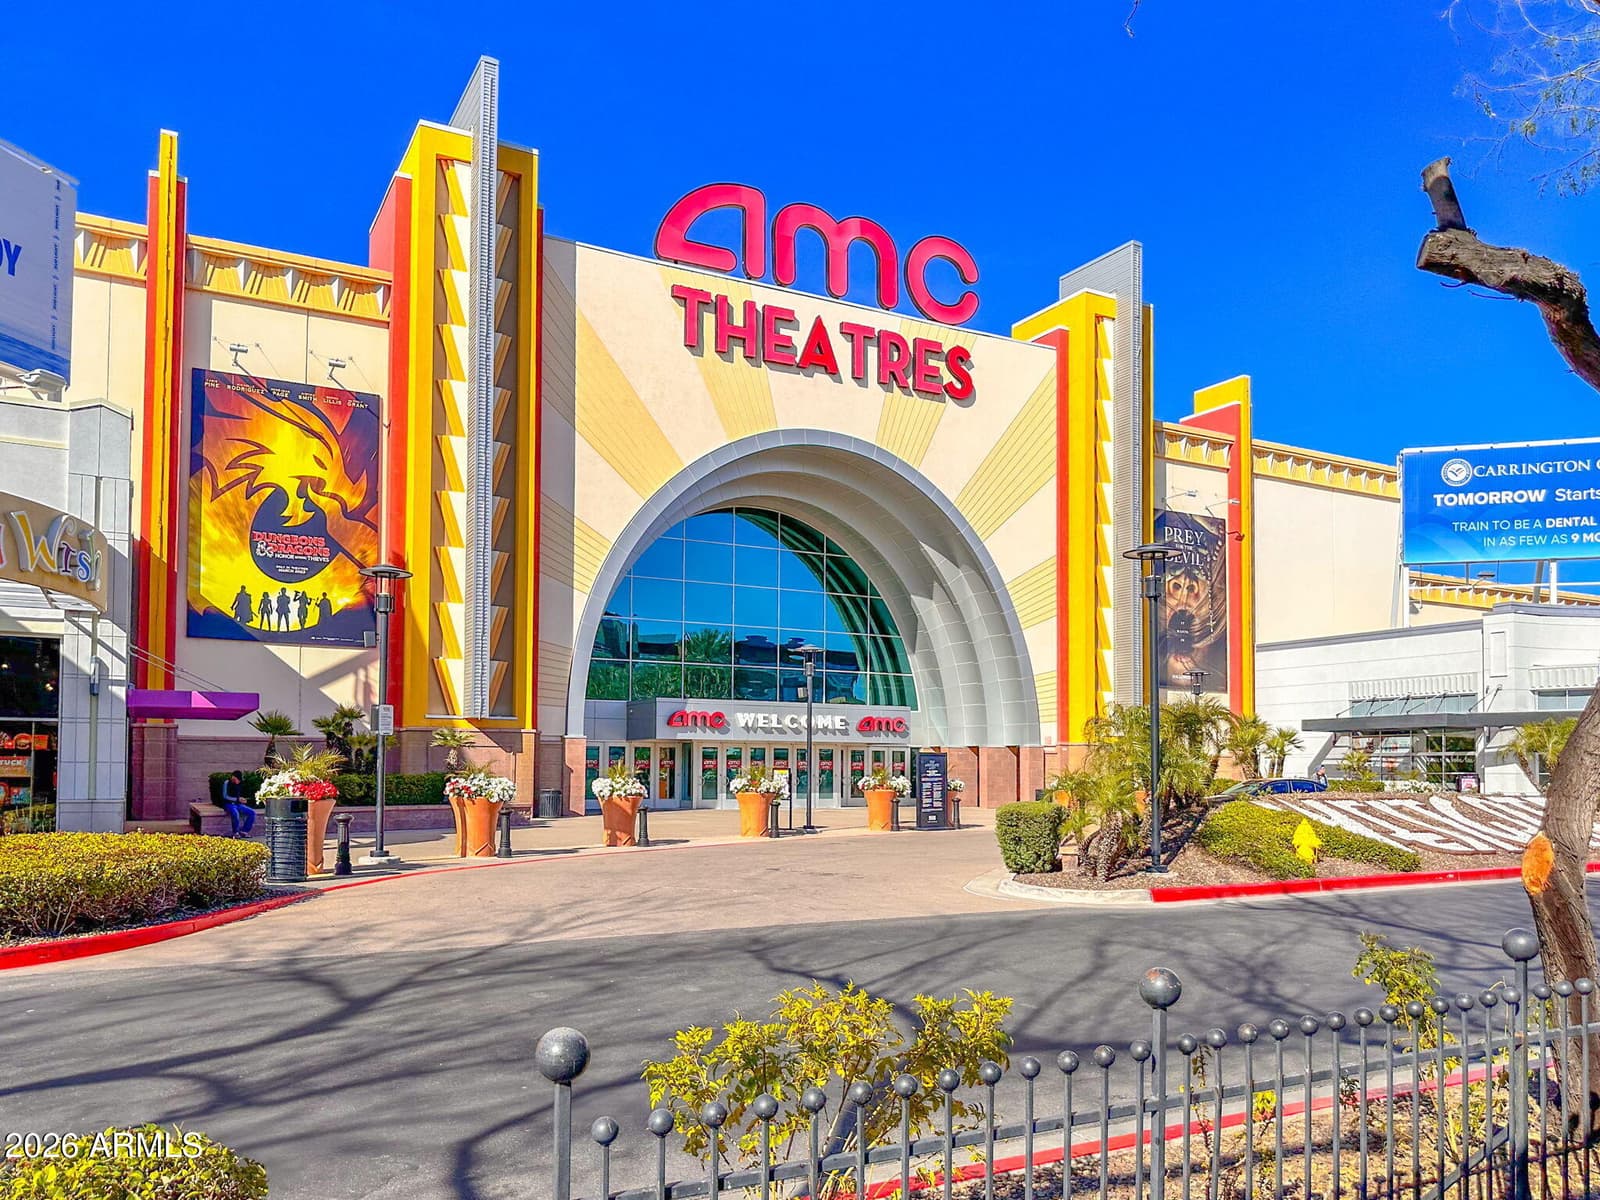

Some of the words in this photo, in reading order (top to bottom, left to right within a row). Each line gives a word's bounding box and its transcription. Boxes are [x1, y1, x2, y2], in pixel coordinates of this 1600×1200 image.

[671, 284, 975, 400] THEATRES
[226, 384, 266, 395] RODRIGUEZ
[1473, 459, 1591, 477] CARRINGTON
[1433, 489, 1546, 507] TOMORROW
[1452, 520, 1489, 532] TRAIN
[1492, 519, 1511, 530] TO
[1514, 519, 1530, 530] BE
[1533, 518, 1542, 529] A
[1545, 516, 1597, 529] DENTAL
[252, 530, 326, 547] DUNGEONS
[1164, 526, 1204, 546] PREY
[1483, 536, 1496, 547] IN
[1499, 536, 1516, 547] AS
[1519, 535, 1548, 546] FEW
[1551, 534, 1568, 545] AS
[1571, 532, 1580, 544] 9
[267, 542, 331, 557] DRAGONS
[736, 712, 847, 730] WELCOME
